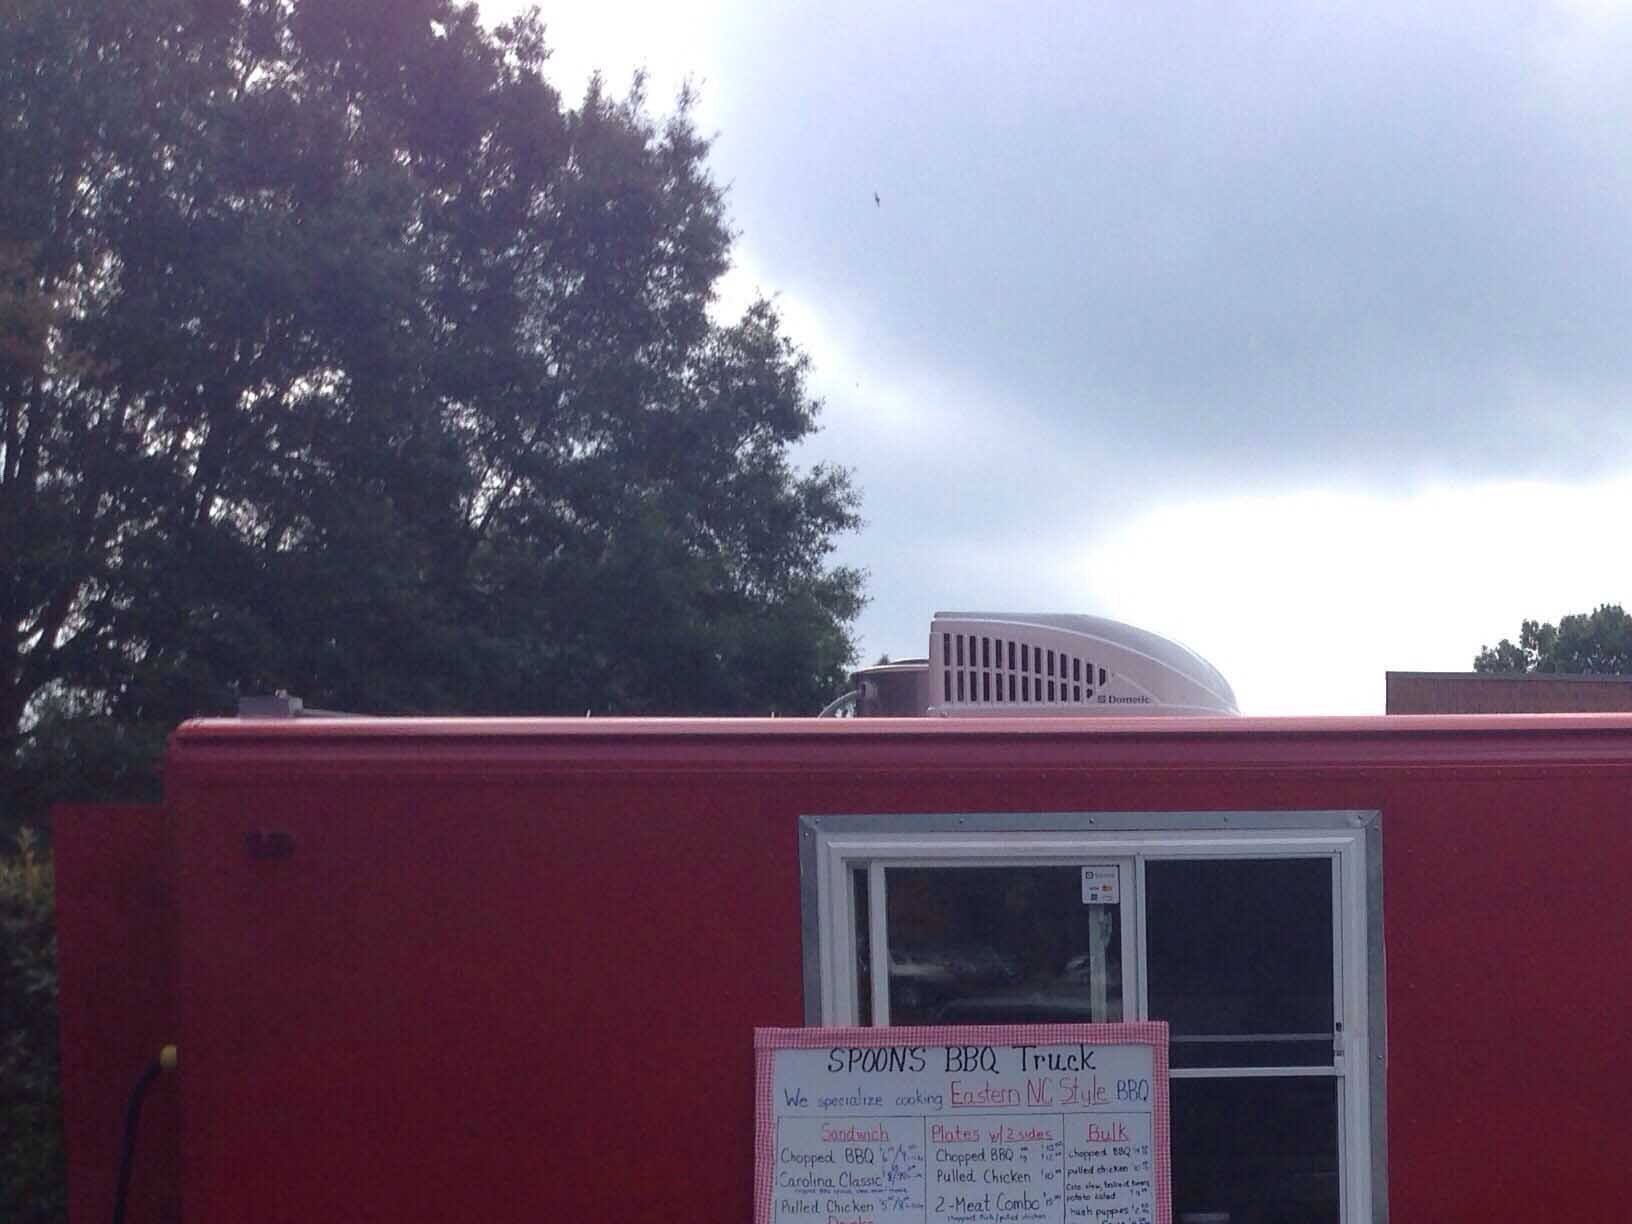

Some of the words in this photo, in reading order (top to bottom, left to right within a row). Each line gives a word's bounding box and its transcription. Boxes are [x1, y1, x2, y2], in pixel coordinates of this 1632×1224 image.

[944, 1045, 999, 1074] BBQ
[1012, 1044, 1096, 1072] Truck
[784, 1087, 808, 1108] We
[816, 1086, 883, 1110] specialize
[895, 1087, 943, 1110] cooking
[950, 1080, 1021, 1107] Eastern
[1027, 1078, 1053, 1107] NC
[1059, 1075, 1112, 1107] Style
[1116, 1078, 1150, 1101] BBQ
[821, 1122, 890, 1142] Sandwich
[931, 1124, 980, 1143] Plates
[1086, 1121, 1129, 1142] Bulk
[780, 1147, 834, 1168] Chopped
[844, 1147, 874, 1165] BBQ
[935, 1147, 987, 1166] Chopped
[990, 1147, 1014, 1162] BBQ
[1112, 1146, 1131, 1158] BBQ
[779, 1171, 836, 1188] Carolina
[838, 1171, 882, 1188] Classic
[936, 1167, 977, 1184] Pulled
[983, 1167, 1032, 1184] Chicken
[781, 1199, 821, 1215] Pulled
[826, 1199, 875, 1214] Chicken
[996, 1190, 1041, 1212] Combo
